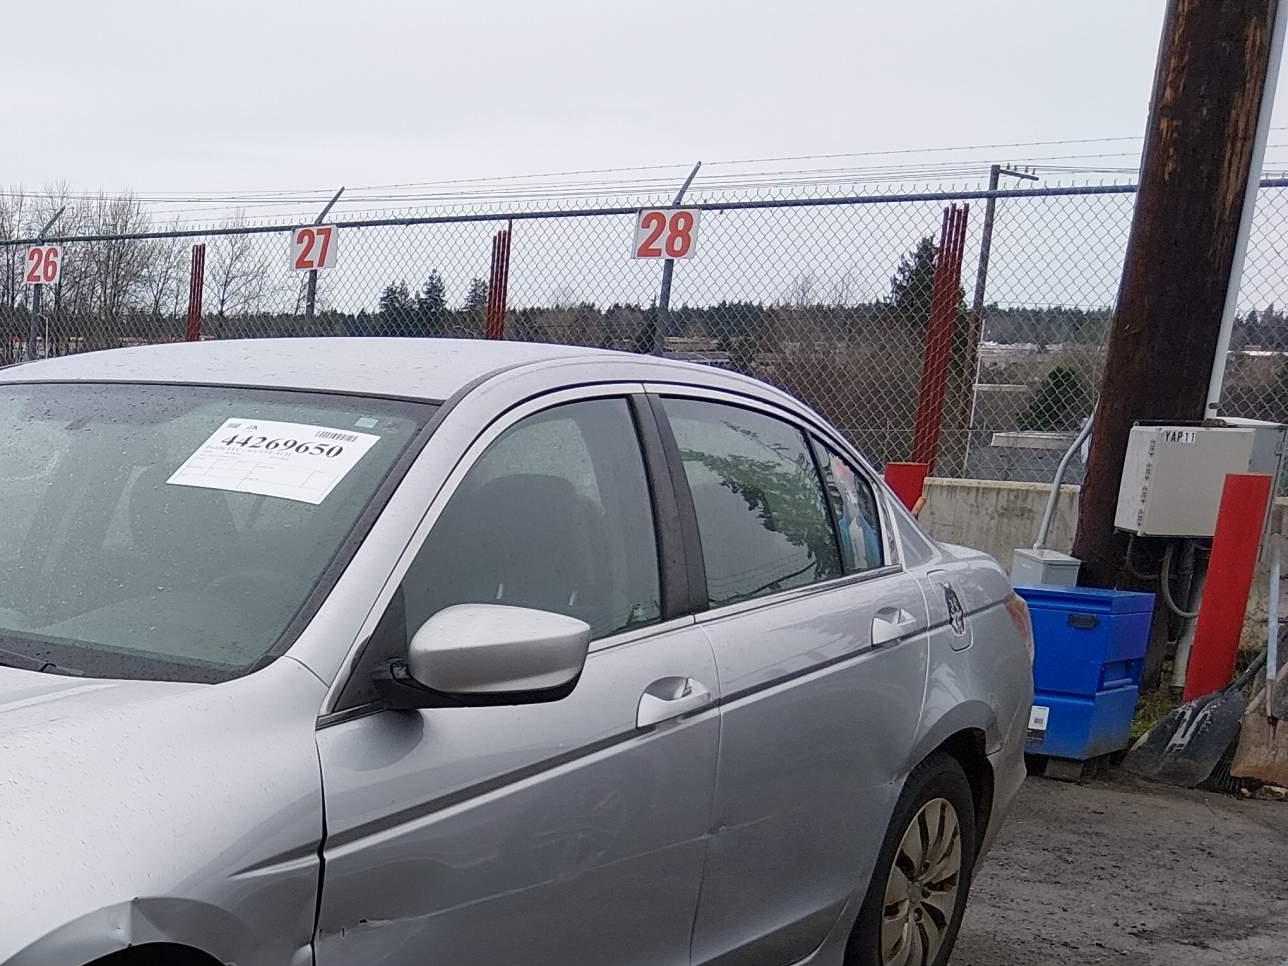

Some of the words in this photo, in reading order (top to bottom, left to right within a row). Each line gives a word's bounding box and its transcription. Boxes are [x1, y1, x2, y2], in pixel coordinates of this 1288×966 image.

[295, 228, 333, 270] 27
[637, 211, 694, 258] 28
[26, 247, 59, 283] 26
[221, 434, 344, 458] 44269650
